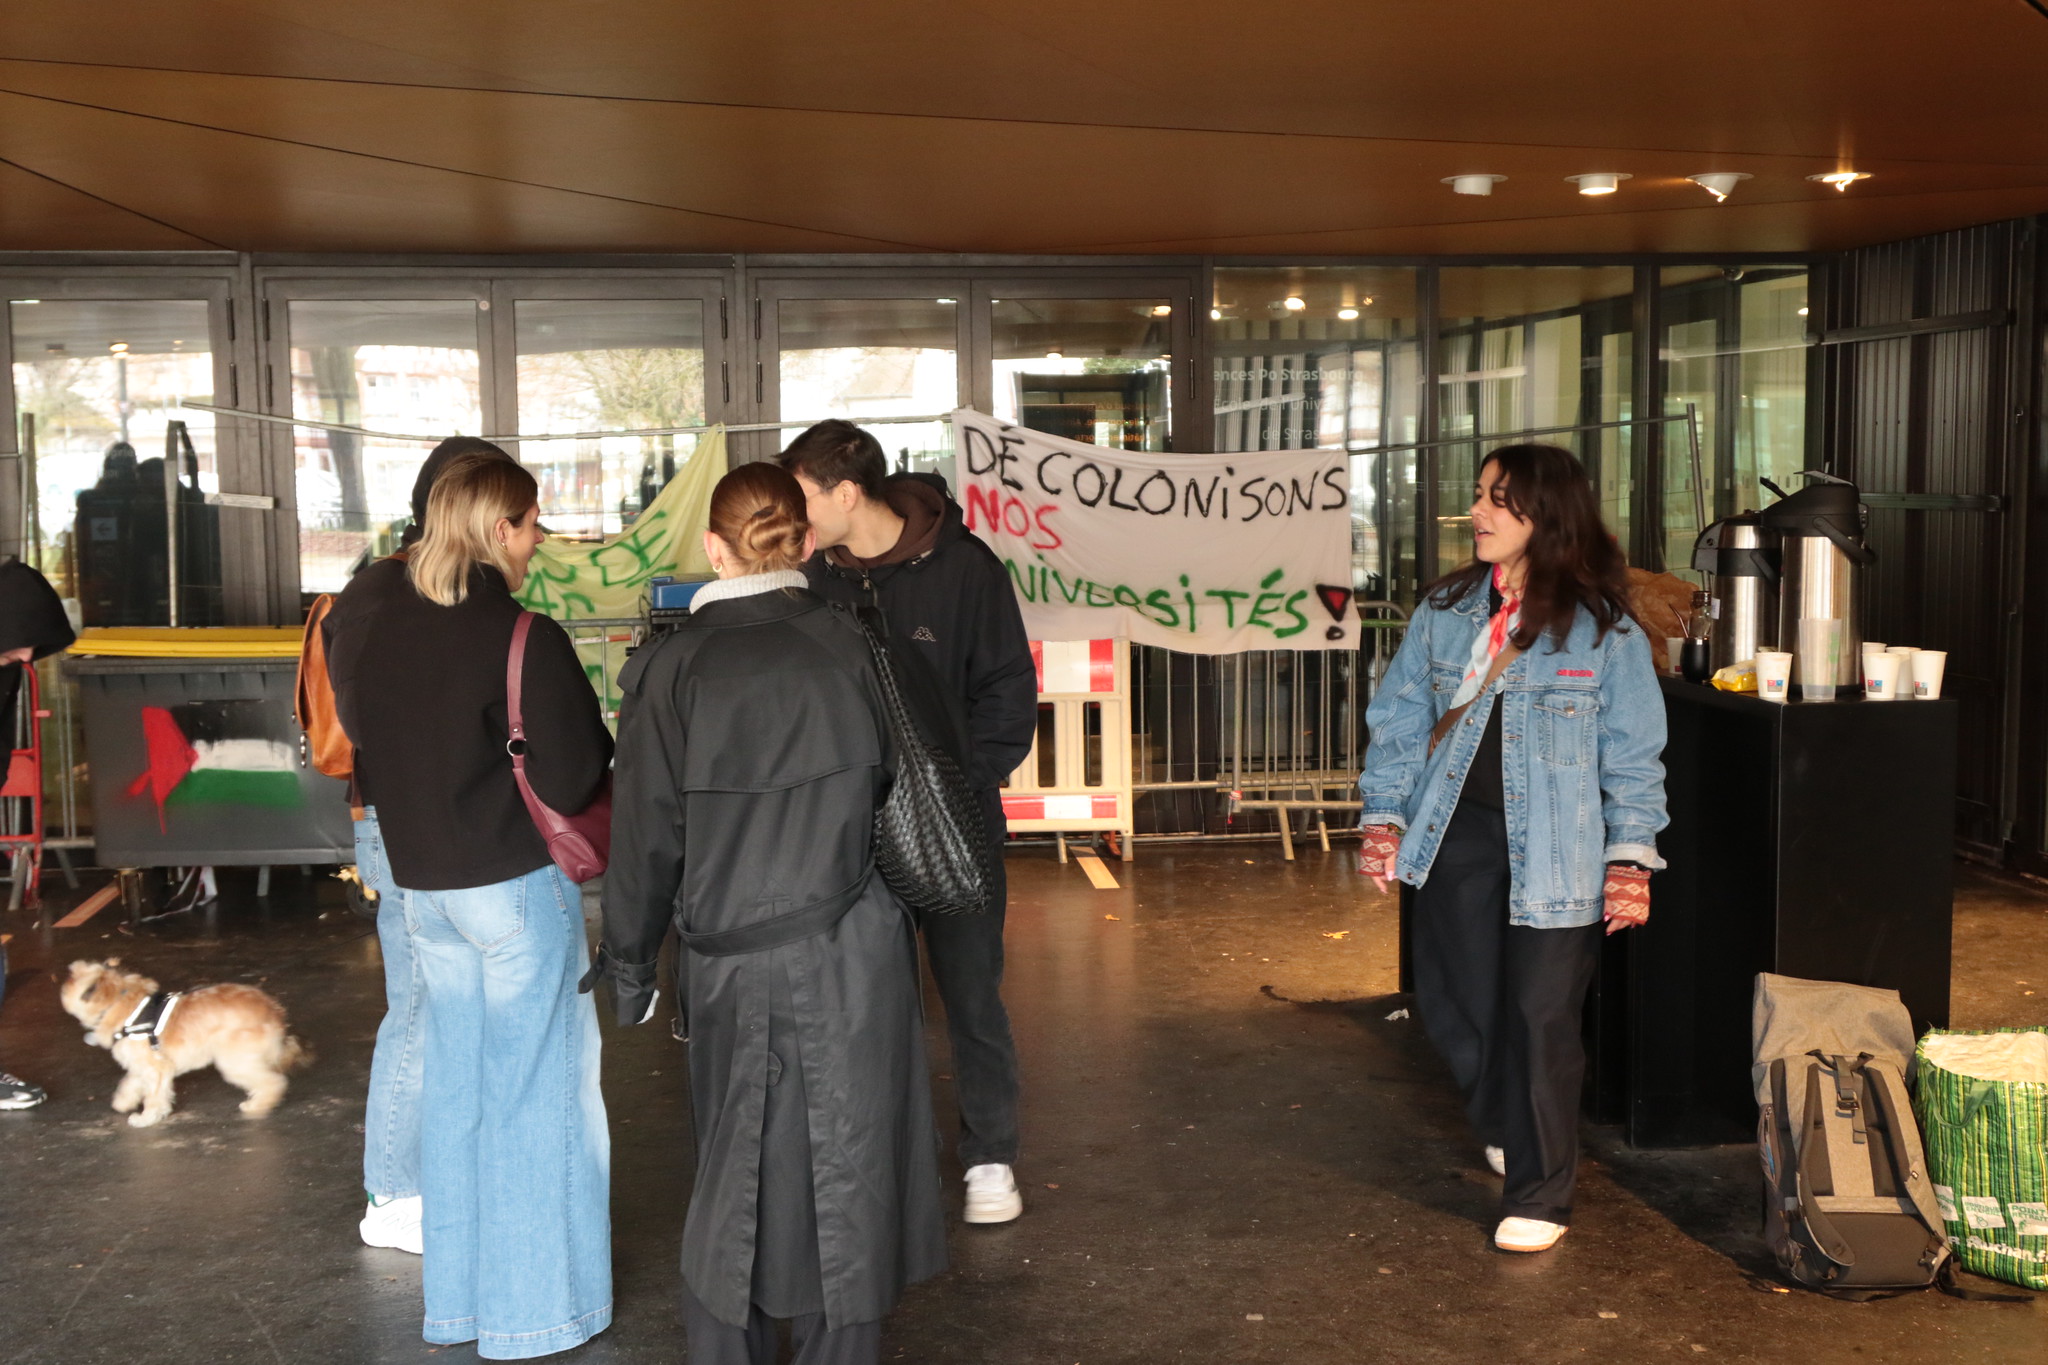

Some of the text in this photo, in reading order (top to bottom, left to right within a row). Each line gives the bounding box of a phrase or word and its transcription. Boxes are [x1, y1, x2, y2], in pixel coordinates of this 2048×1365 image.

[1214, 369, 1254, 380] ences
[1259, 368, 1277, 380] Po
[966, 483, 1063, 549] NOS
[2011, 1204, 2046, 1217] POINT
